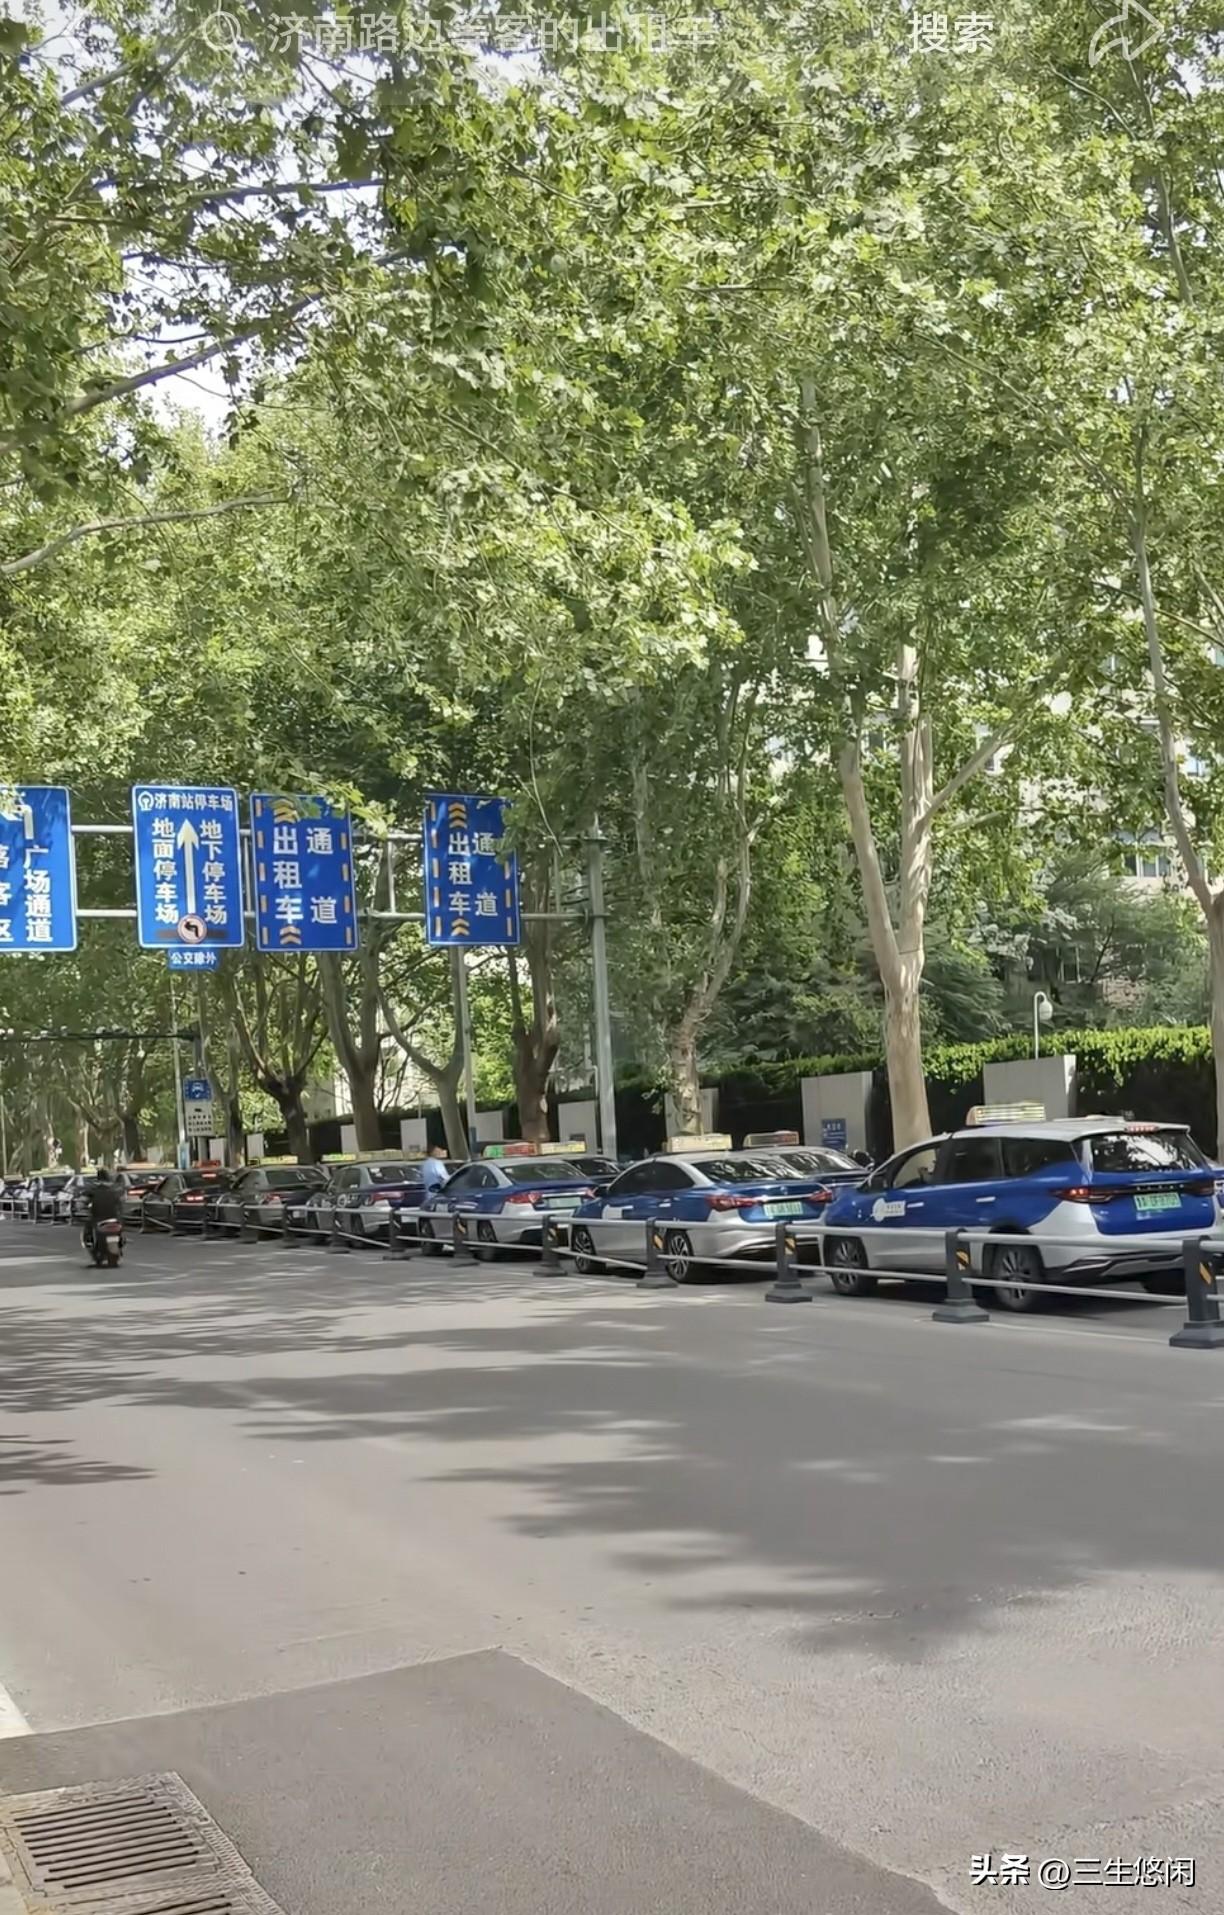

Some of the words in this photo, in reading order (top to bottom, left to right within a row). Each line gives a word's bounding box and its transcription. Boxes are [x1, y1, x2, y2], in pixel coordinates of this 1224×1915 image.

[155, 793, 233, 811] 济南站停车场
[23, 845, 53, 942] 广场通道
[152, 818, 179, 924] 地面停车场
[200, 819, 228, 925] 地下停车场
[273, 826, 304, 924] 出租车
[448, 832, 473, 916] 出租车
